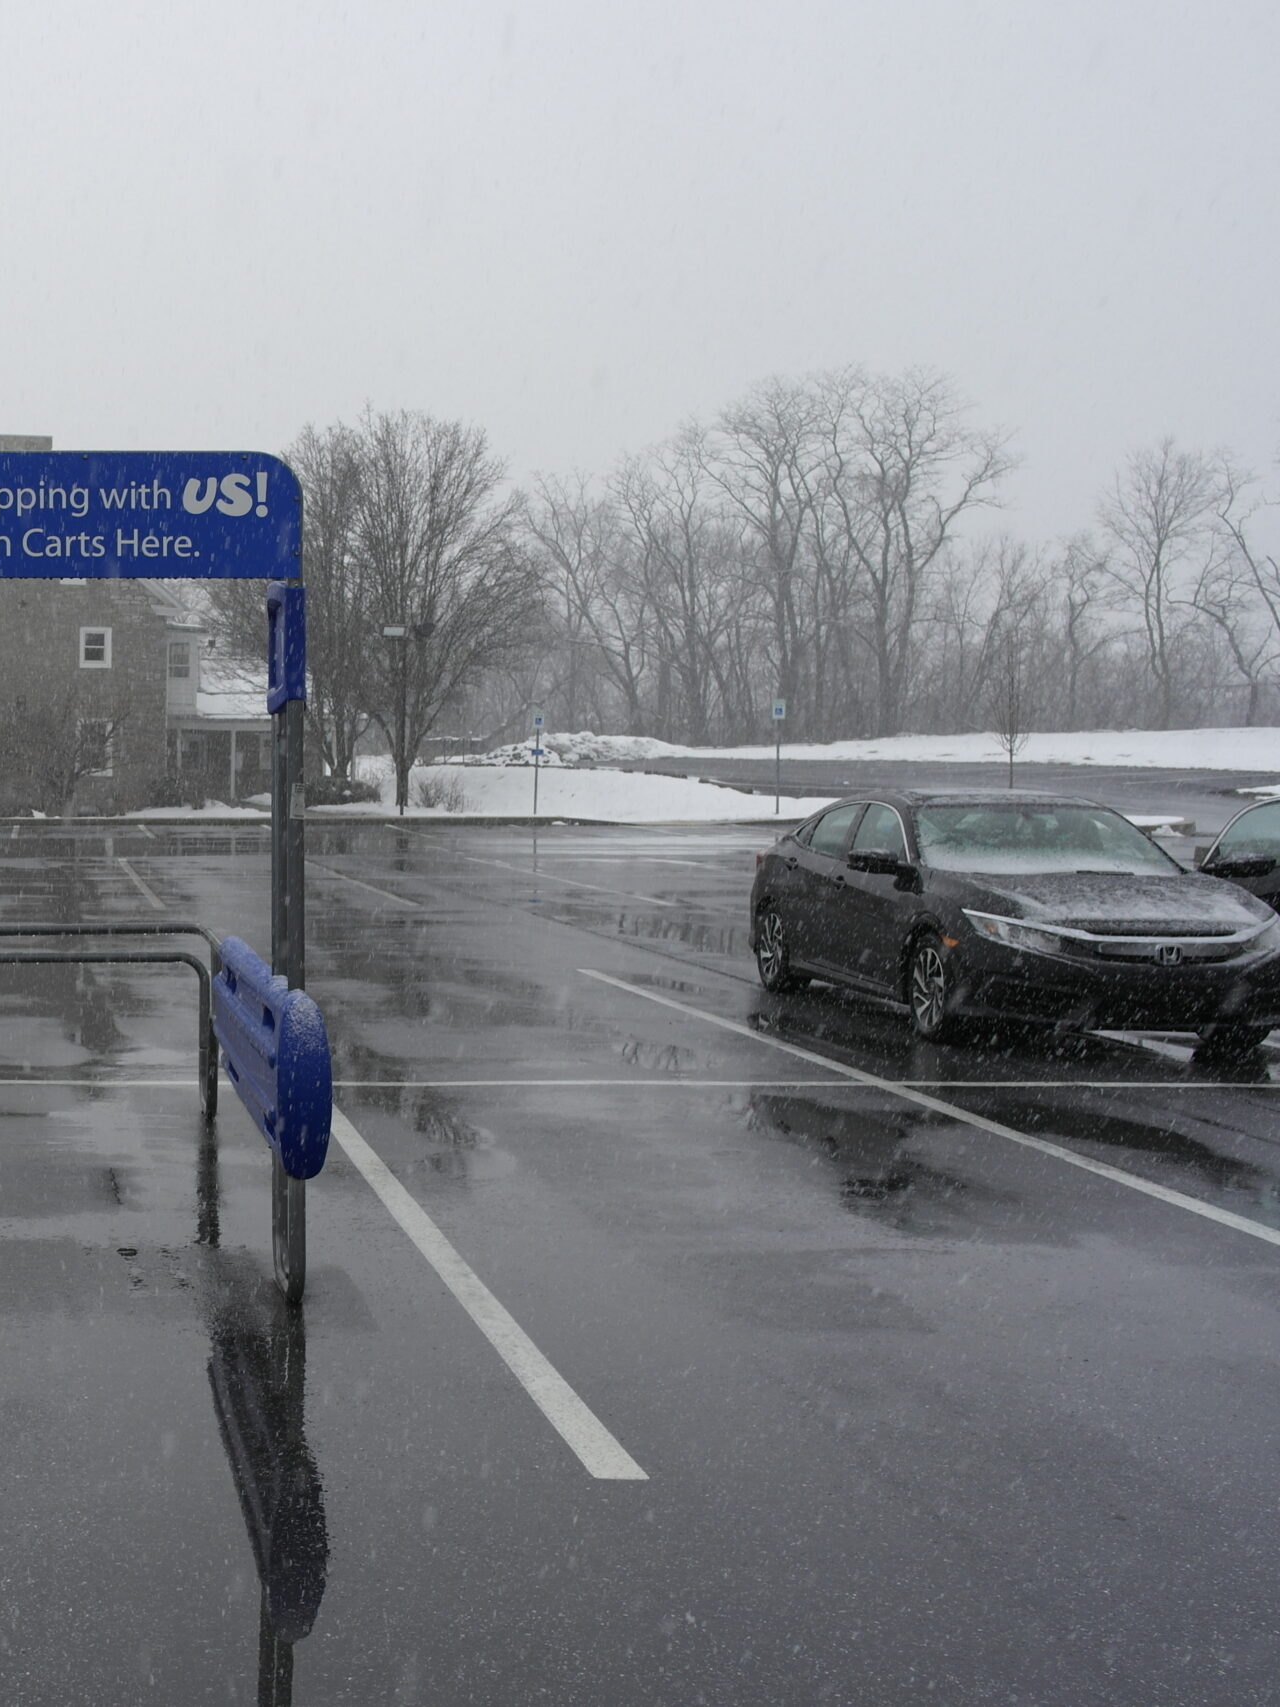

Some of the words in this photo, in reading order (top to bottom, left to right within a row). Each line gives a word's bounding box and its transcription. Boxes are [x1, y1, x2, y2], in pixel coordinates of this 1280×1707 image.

[99, 479, 171, 509] with
[22, 528, 105, 557] Carts
[117, 528, 200, 557] Here.
